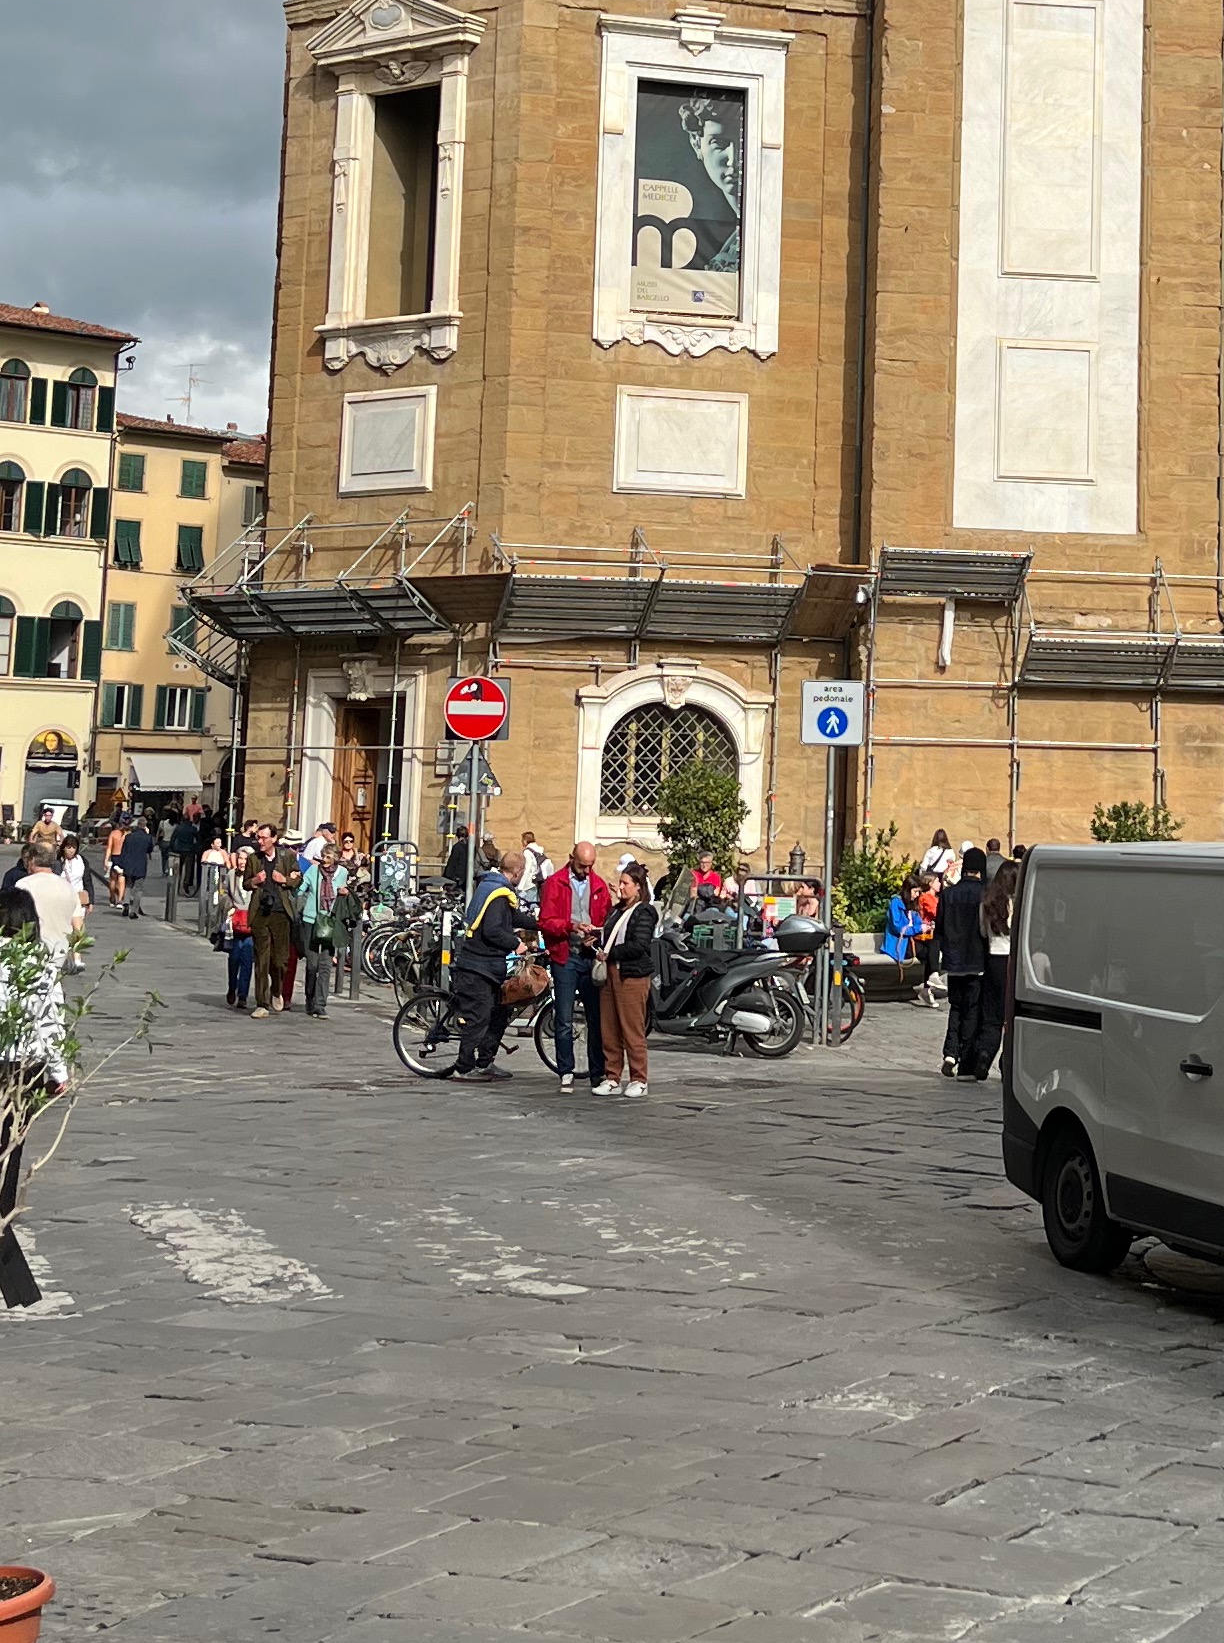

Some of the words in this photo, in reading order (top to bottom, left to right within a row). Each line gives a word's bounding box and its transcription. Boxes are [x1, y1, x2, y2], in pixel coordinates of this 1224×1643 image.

[642, 184, 679, 194] CAPPELLE
[642, 193, 678, 202] MEDICEE
[813, 695, 854, 703] pedonale
